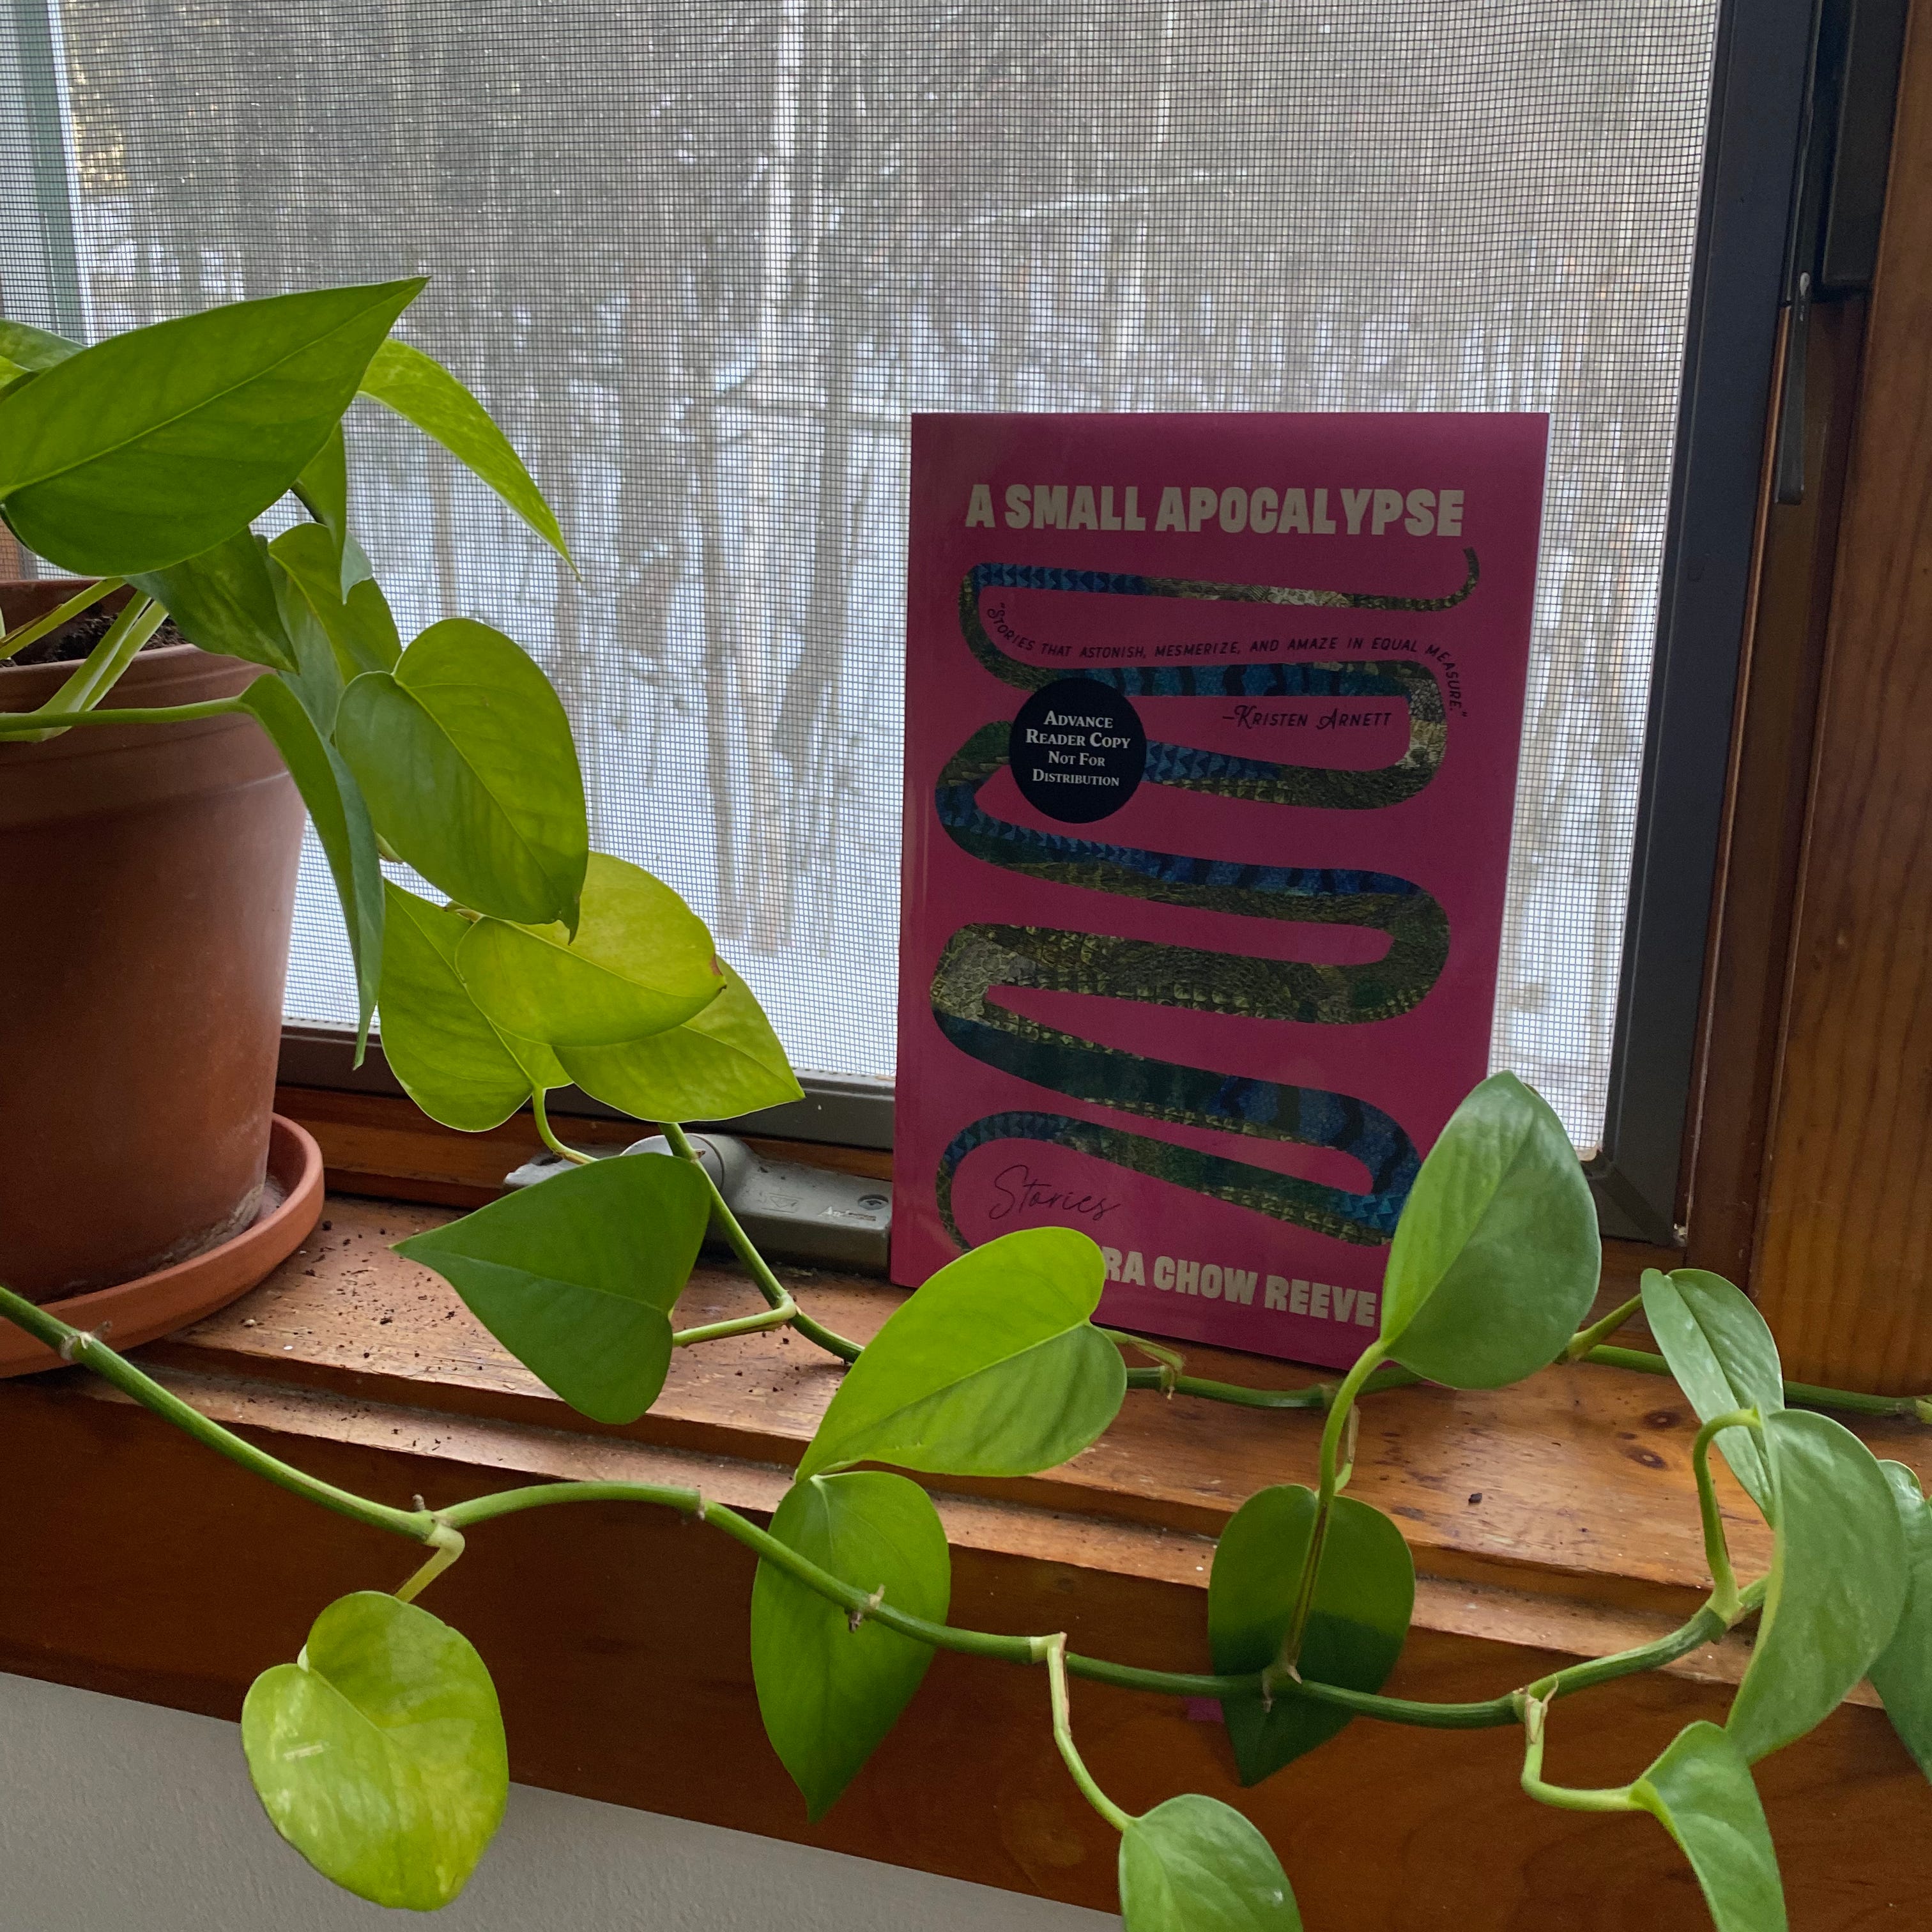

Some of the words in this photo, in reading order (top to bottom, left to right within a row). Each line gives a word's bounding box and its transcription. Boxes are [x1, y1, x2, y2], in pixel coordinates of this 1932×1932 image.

[965, 484, 996, 528] A
[1004, 484, 1146, 531] SMALL
[1154, 486, 1464, 537] APOCALYPSE
[1041, 643, 1073, 656] THAT
[1079, 646, 1147, 659] ASTONISH,
[1154, 641, 1241, 657] MESMERIZE,
[1250, 639, 1279, 652] AND
[1287, 637, 1338, 650] AMAZE
[1347, 638, 1363, 649] IN
[1371, 637, 1417, 653] EQUAL
[1043, 710, 1114, 728] ADVANCE
[1315, 708, 1392, 730] ARNETT
[1025, 728, 1085, 746] READER
[1089, 732, 1131, 749] COPY
[1048, 751, 1077, 764] NOT
[1079, 752, 1105, 767] FOR
[1032, 769, 1119, 786] DISTRIBUTION
[989, 1165, 1121, 1221] Stories
[1154, 1255, 1259, 1305] CHOW
[1264, 1275, 1377, 1327] REEVE
